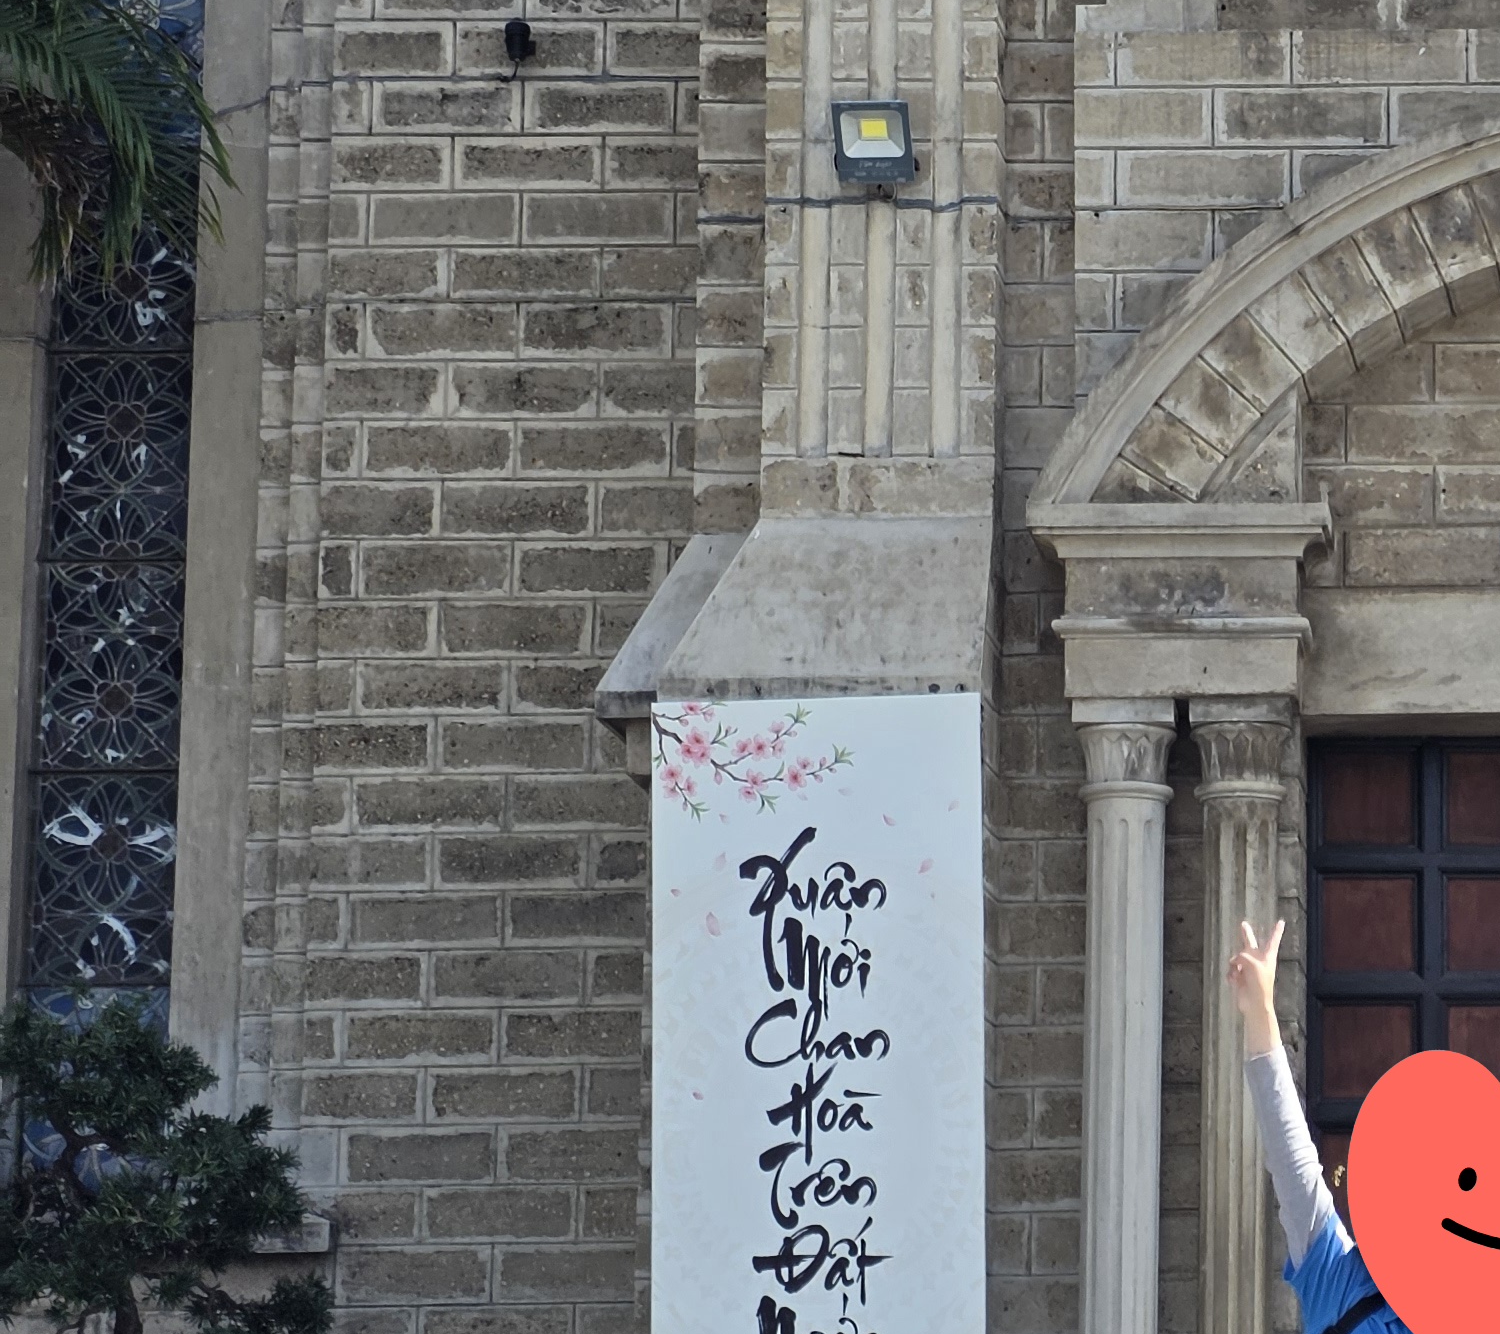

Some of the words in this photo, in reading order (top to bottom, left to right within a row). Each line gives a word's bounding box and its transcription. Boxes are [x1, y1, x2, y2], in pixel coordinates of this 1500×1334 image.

[739, 827, 888, 992] Xuân
[777, 913, 872, 1021] Mới
[745, 993, 890, 1068] Chan
[766, 1062, 882, 1165] Hoà
[759, 1142, 877, 1229] Trên
[753, 1217, 894, 1306] Đất
